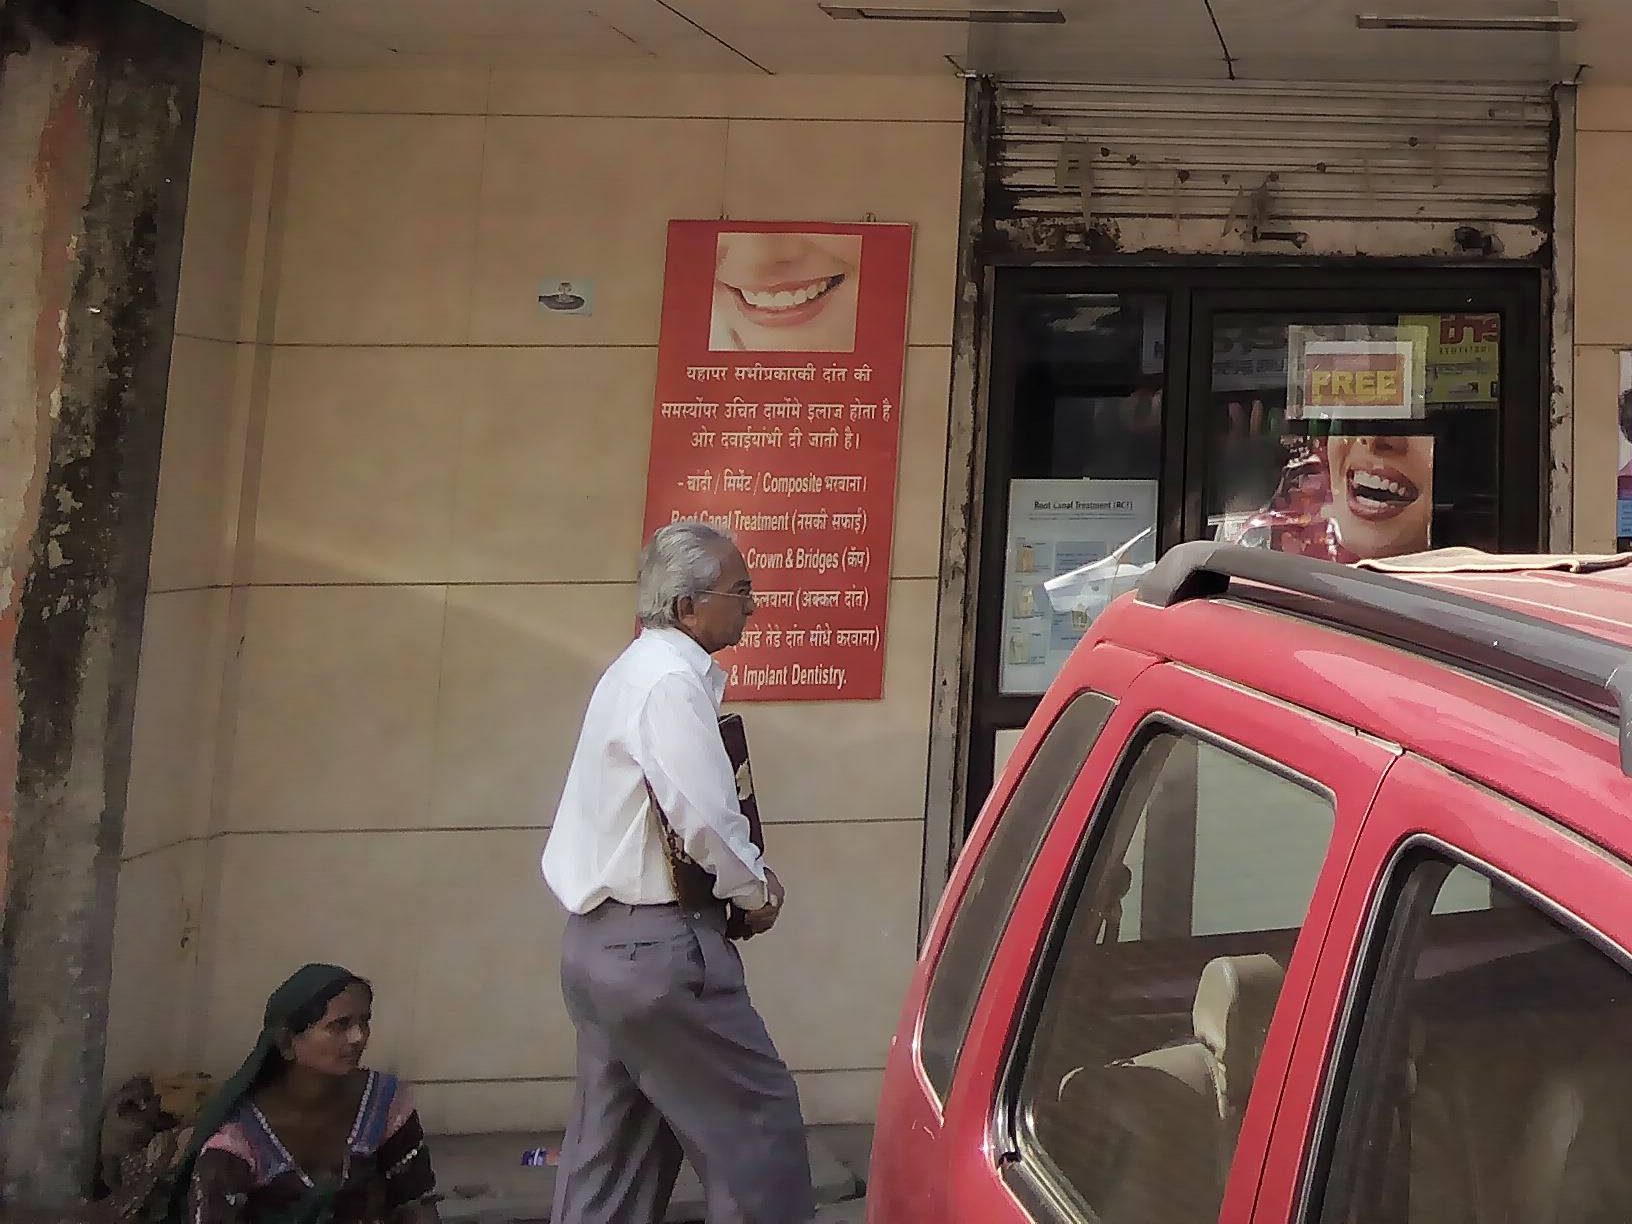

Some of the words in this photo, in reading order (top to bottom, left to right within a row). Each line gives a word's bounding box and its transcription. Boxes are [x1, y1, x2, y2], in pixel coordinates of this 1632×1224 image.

[853, 364, 873, 383] की
[1311, 370, 1397, 396] FREE
[850, 397, 877, 423] होता
[788, 426, 803, 449] दी
[808, 427, 839, 449] जाती
[762, 472, 823, 498] Composite
[733, 510, 789, 531] Treatment
[747, 547, 782, 569] Crown
[786, 547, 796, 569] &
[796, 547, 839, 574] Bridges
[730, 664, 739, 687] &
[743, 664, 789, 691] Implant
[791, 663, 847, 690] Dentistry.
